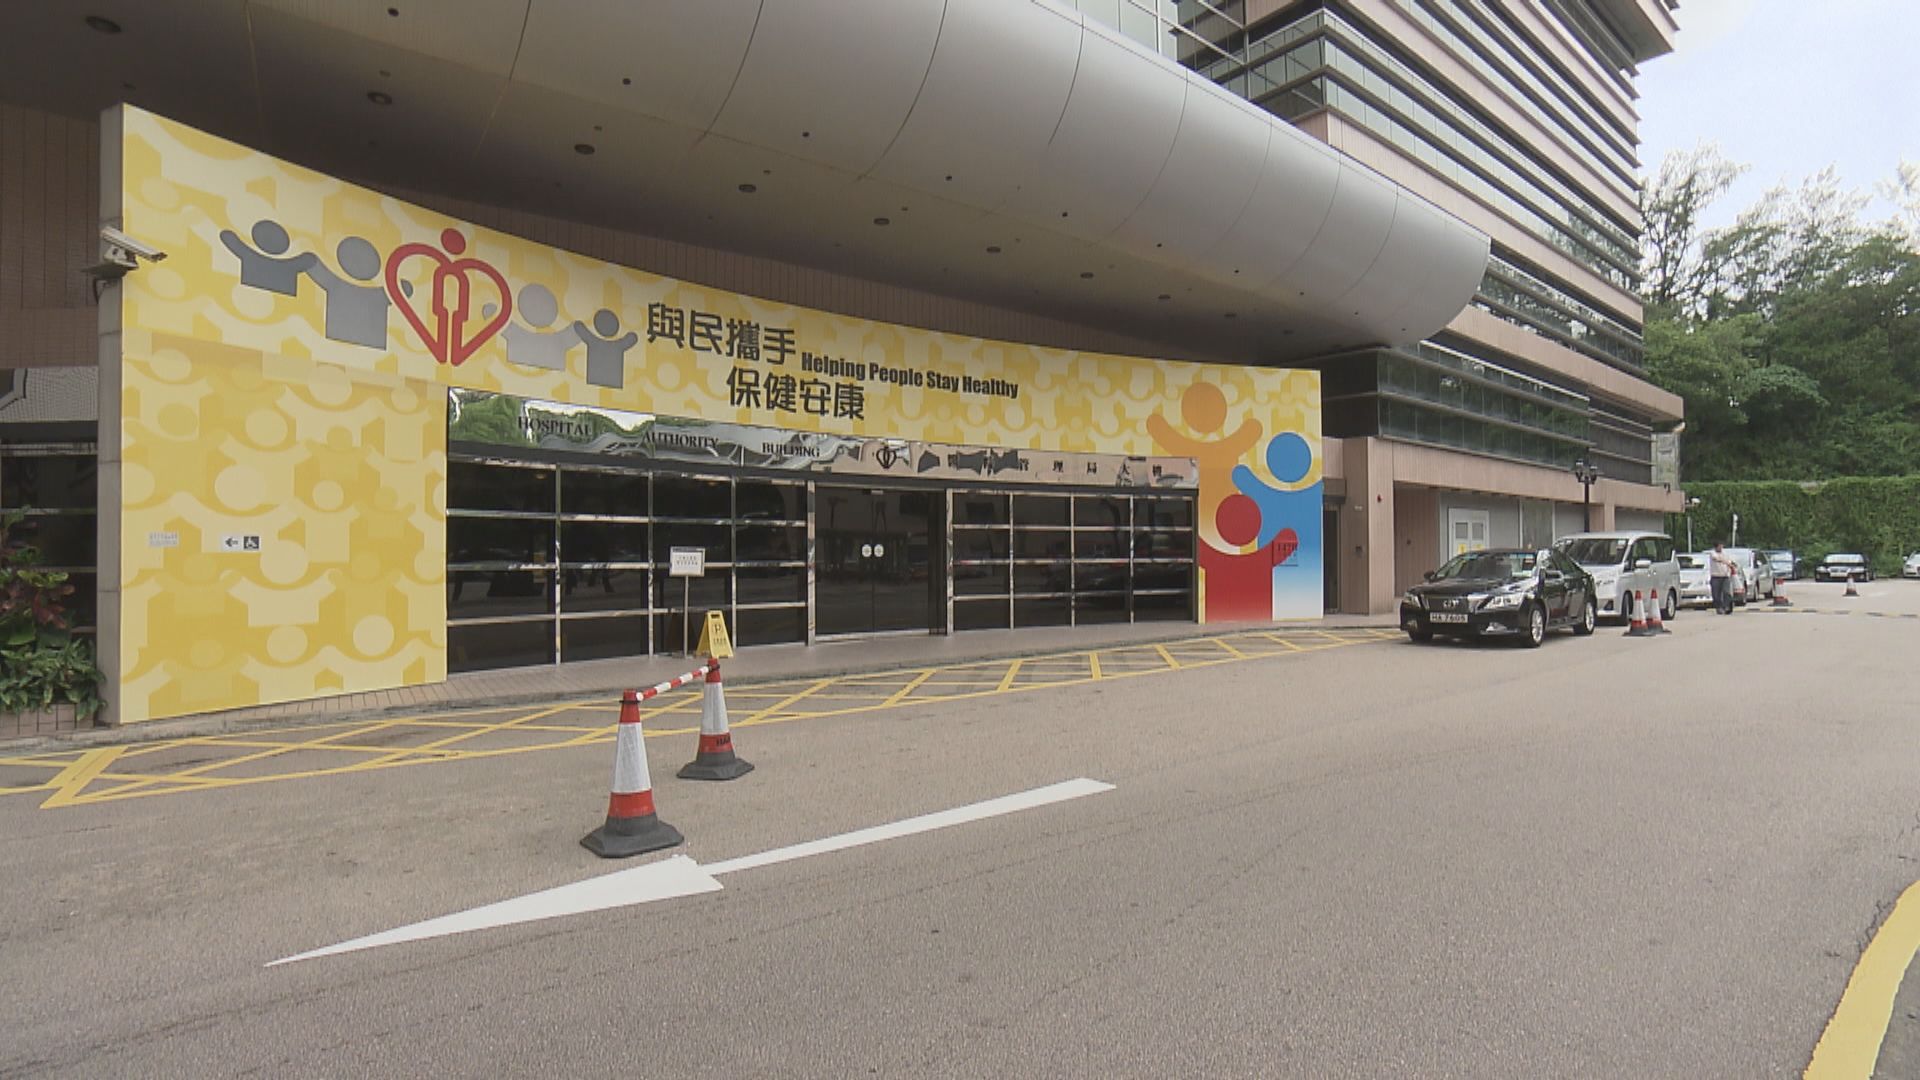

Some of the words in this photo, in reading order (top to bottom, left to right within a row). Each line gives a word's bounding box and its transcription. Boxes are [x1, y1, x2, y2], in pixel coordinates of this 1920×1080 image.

[647, 302, 796, 365] 與民攜手
[726, 366, 864, 420] 保健安康
[801, 352, 865, 381] Helping
[869, 362, 923, 388] People
[926, 370, 959, 393] Stay
[963, 376, 1019, 399] Healthy
[518, 416, 592, 436] HOSPITAL
[642, 431, 719, 449] AUTHORITY
[762, 442, 820, 458] BUILDING
